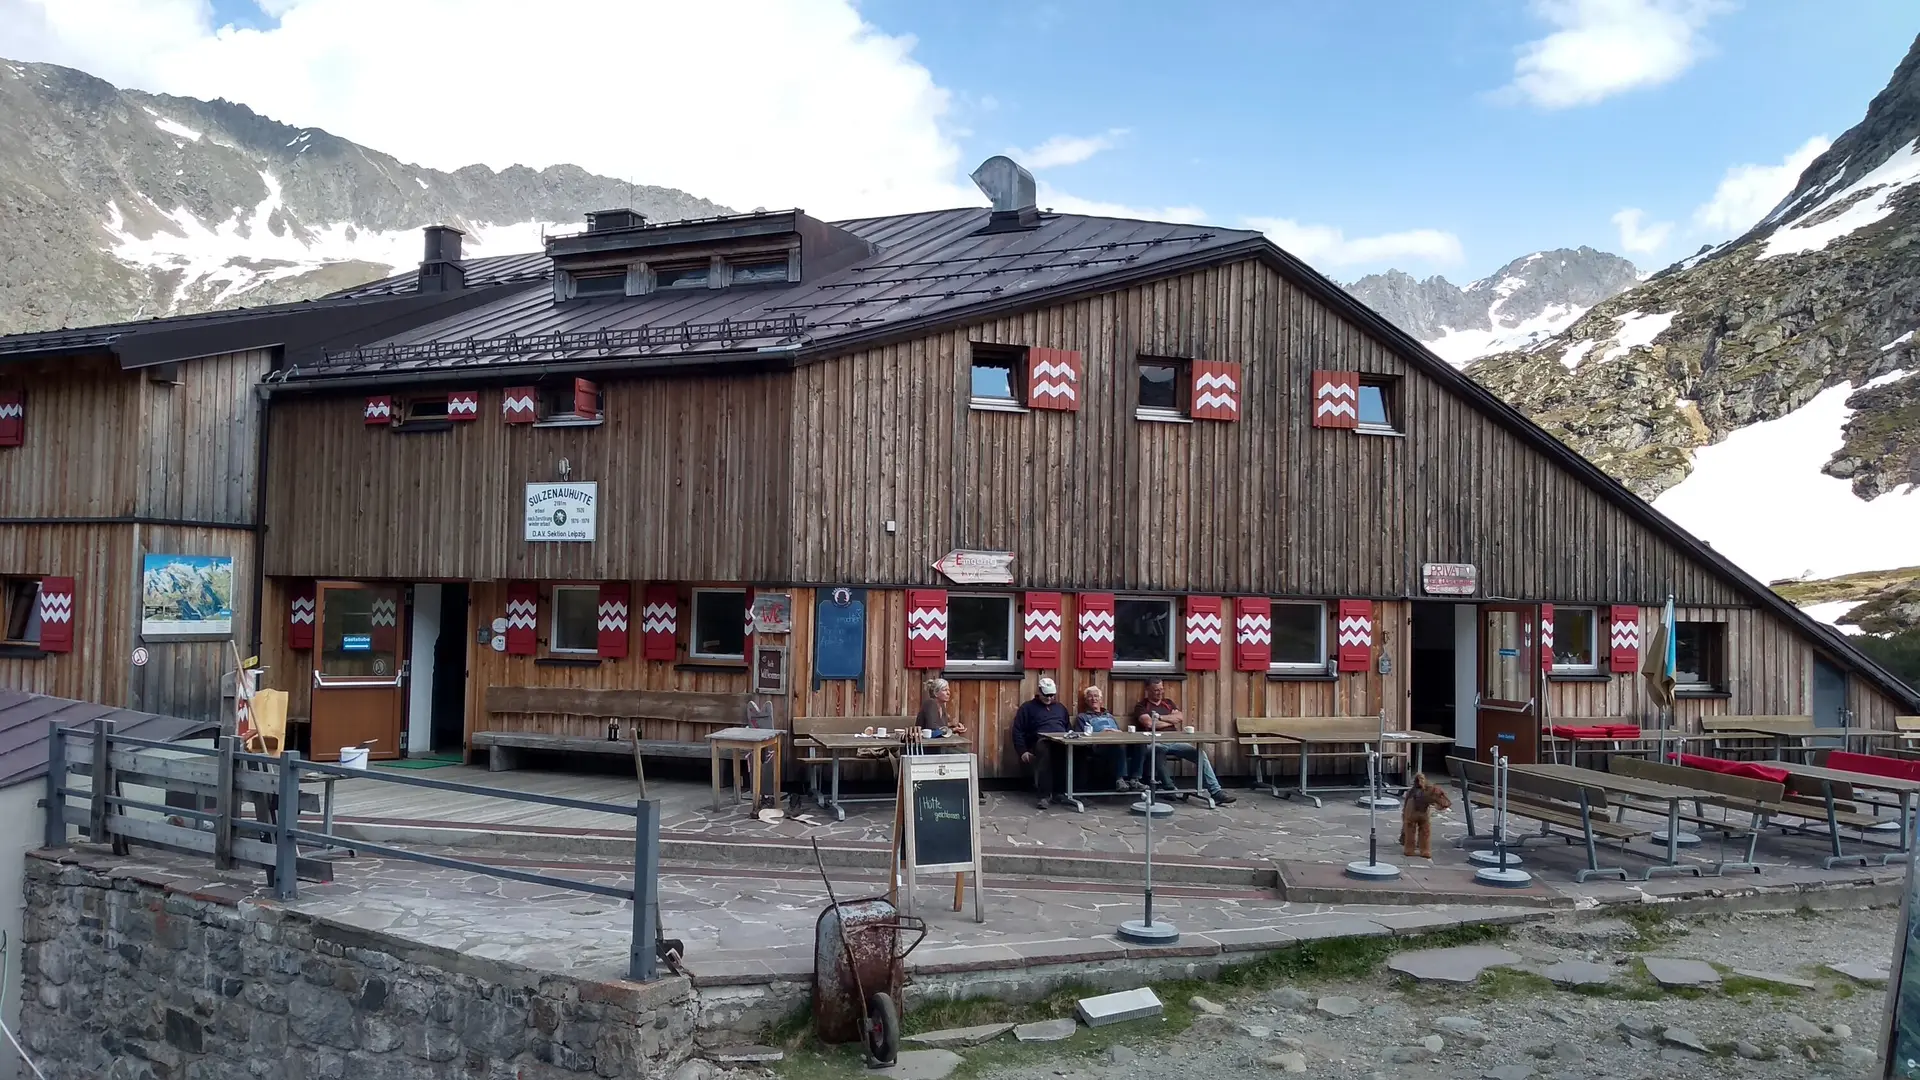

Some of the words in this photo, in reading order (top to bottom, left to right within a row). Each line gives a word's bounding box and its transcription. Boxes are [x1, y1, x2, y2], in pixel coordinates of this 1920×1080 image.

[547, 530, 567, 538] Sektion
[568, 530, 586, 539] Leipzig
[956, 553, 997, 567] Eingang
[762, 603, 785, 625] WC
